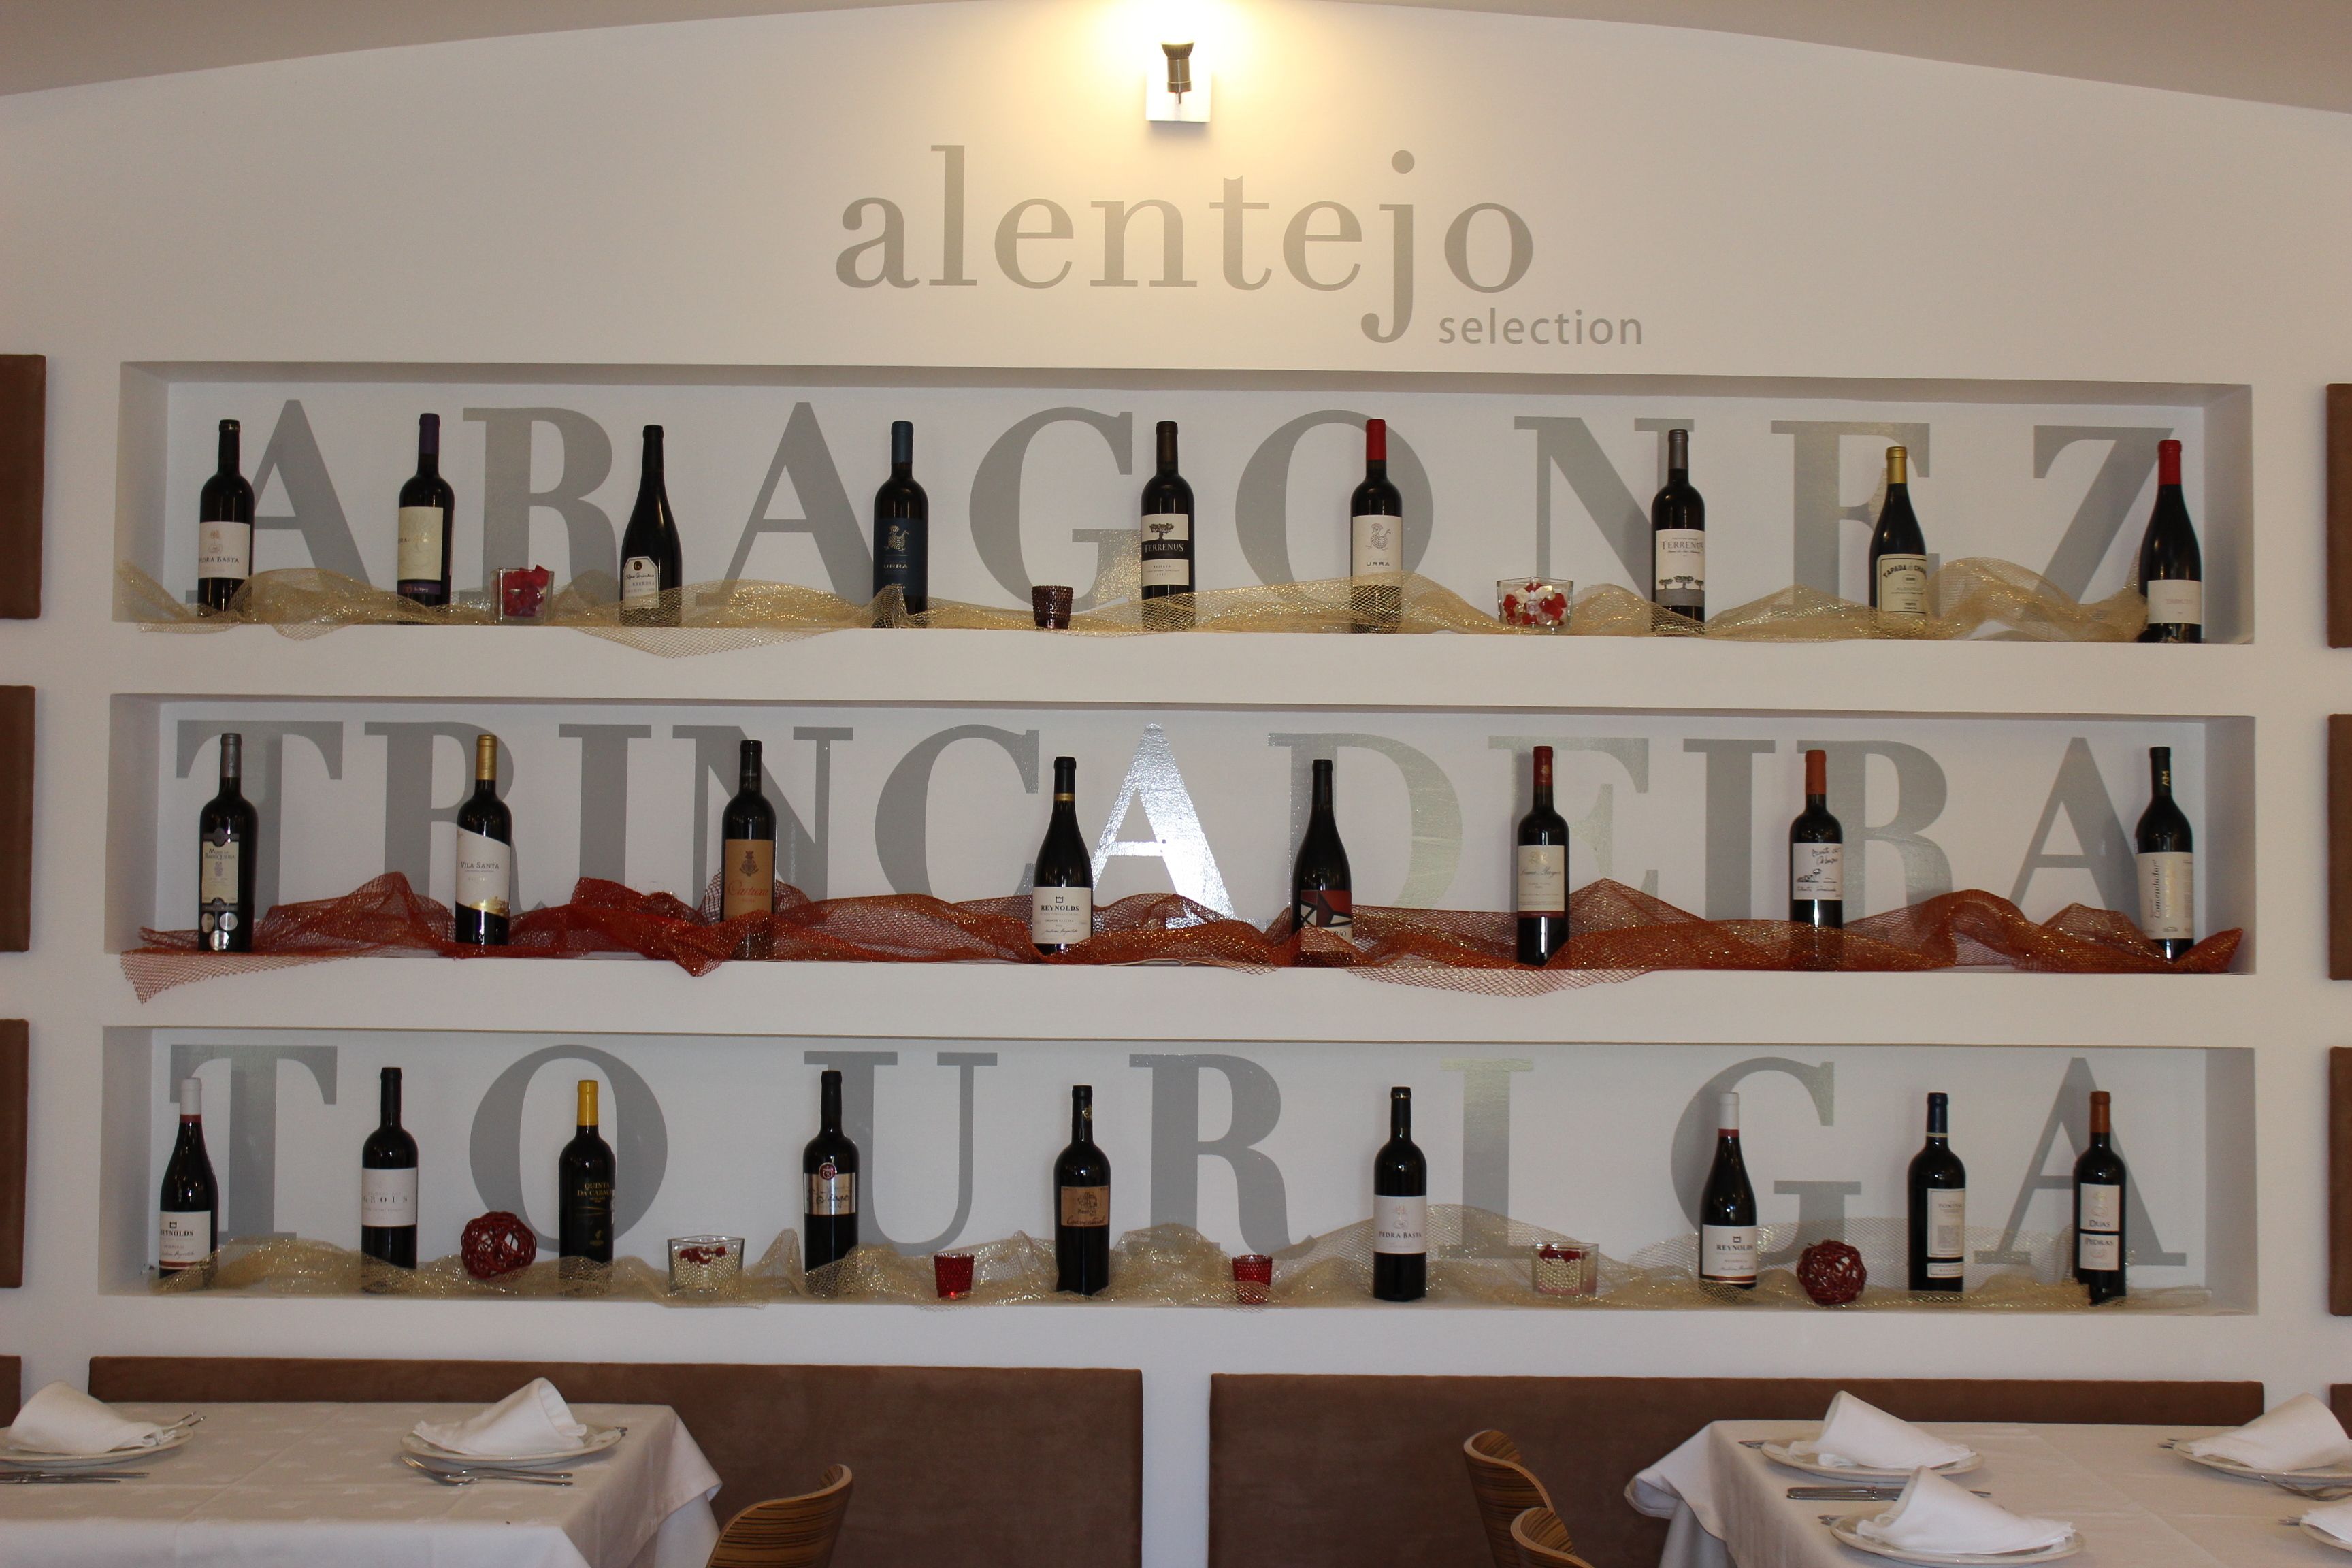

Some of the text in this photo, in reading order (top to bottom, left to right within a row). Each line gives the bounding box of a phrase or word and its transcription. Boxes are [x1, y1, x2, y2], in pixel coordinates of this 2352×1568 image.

[835, 145, 1535, 343] alentejo
[1439, 308, 1644, 345] selection
[184, 399, 2174, 622] ARAGONEZ
[1145, 544, 1184, 553] TERRENUS
[1883, 565, 1906, 578] TAPADA
[177, 719, 2176, 953] TRINCADEIRA
[476, 862, 500, 870] SANTA
[728, 879, 768, 896] Cartuxa
[171, 1043, 2186, 1266] TOURIGA
[584, 1182, 610, 1190] QUINTA
[2089, 1219, 2110, 1228] DUAS
